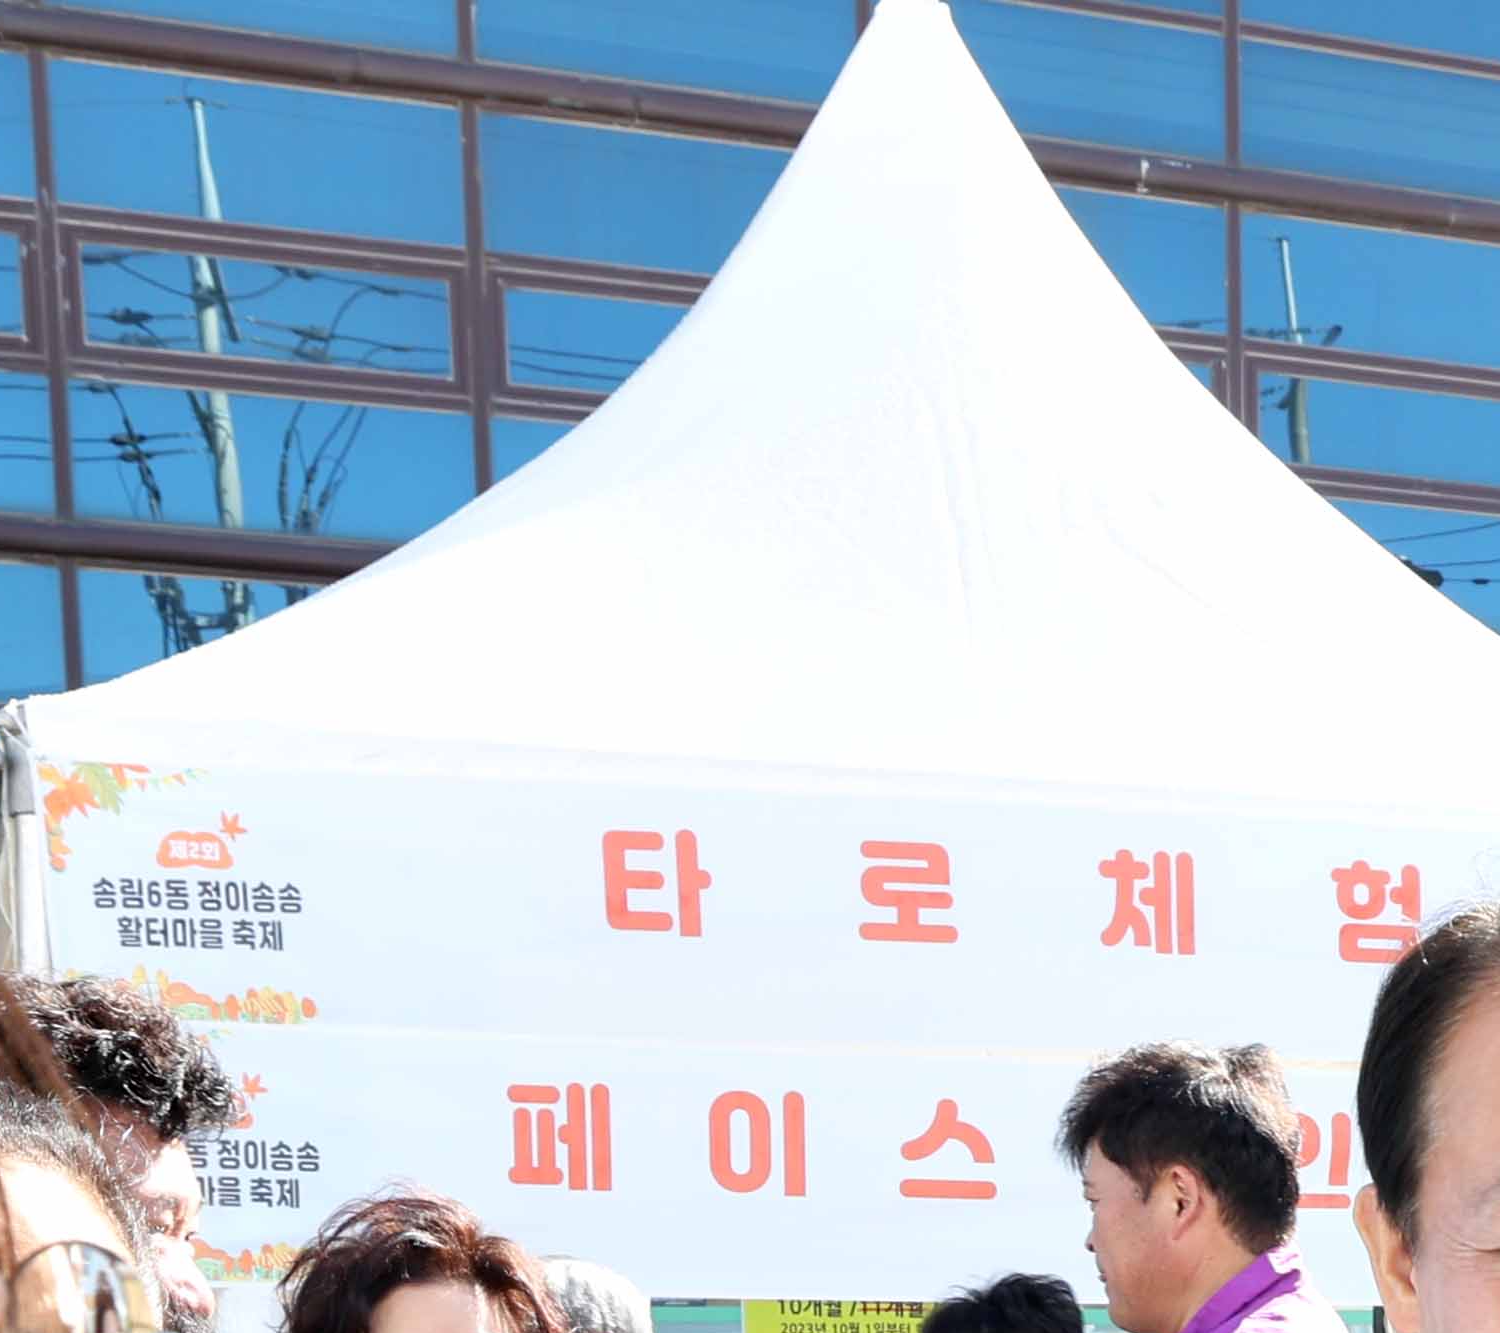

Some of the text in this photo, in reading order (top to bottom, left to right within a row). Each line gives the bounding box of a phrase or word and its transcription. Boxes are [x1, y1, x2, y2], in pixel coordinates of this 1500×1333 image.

[168, 840, 221, 861] 제2회
[93, 877, 302, 913] 송림6동 정이송송
[117, 917, 284, 951] 활터마을 축제
[217, 1139, 320, 1172] 정이송송
[250, 1177, 300, 1208] 축제
